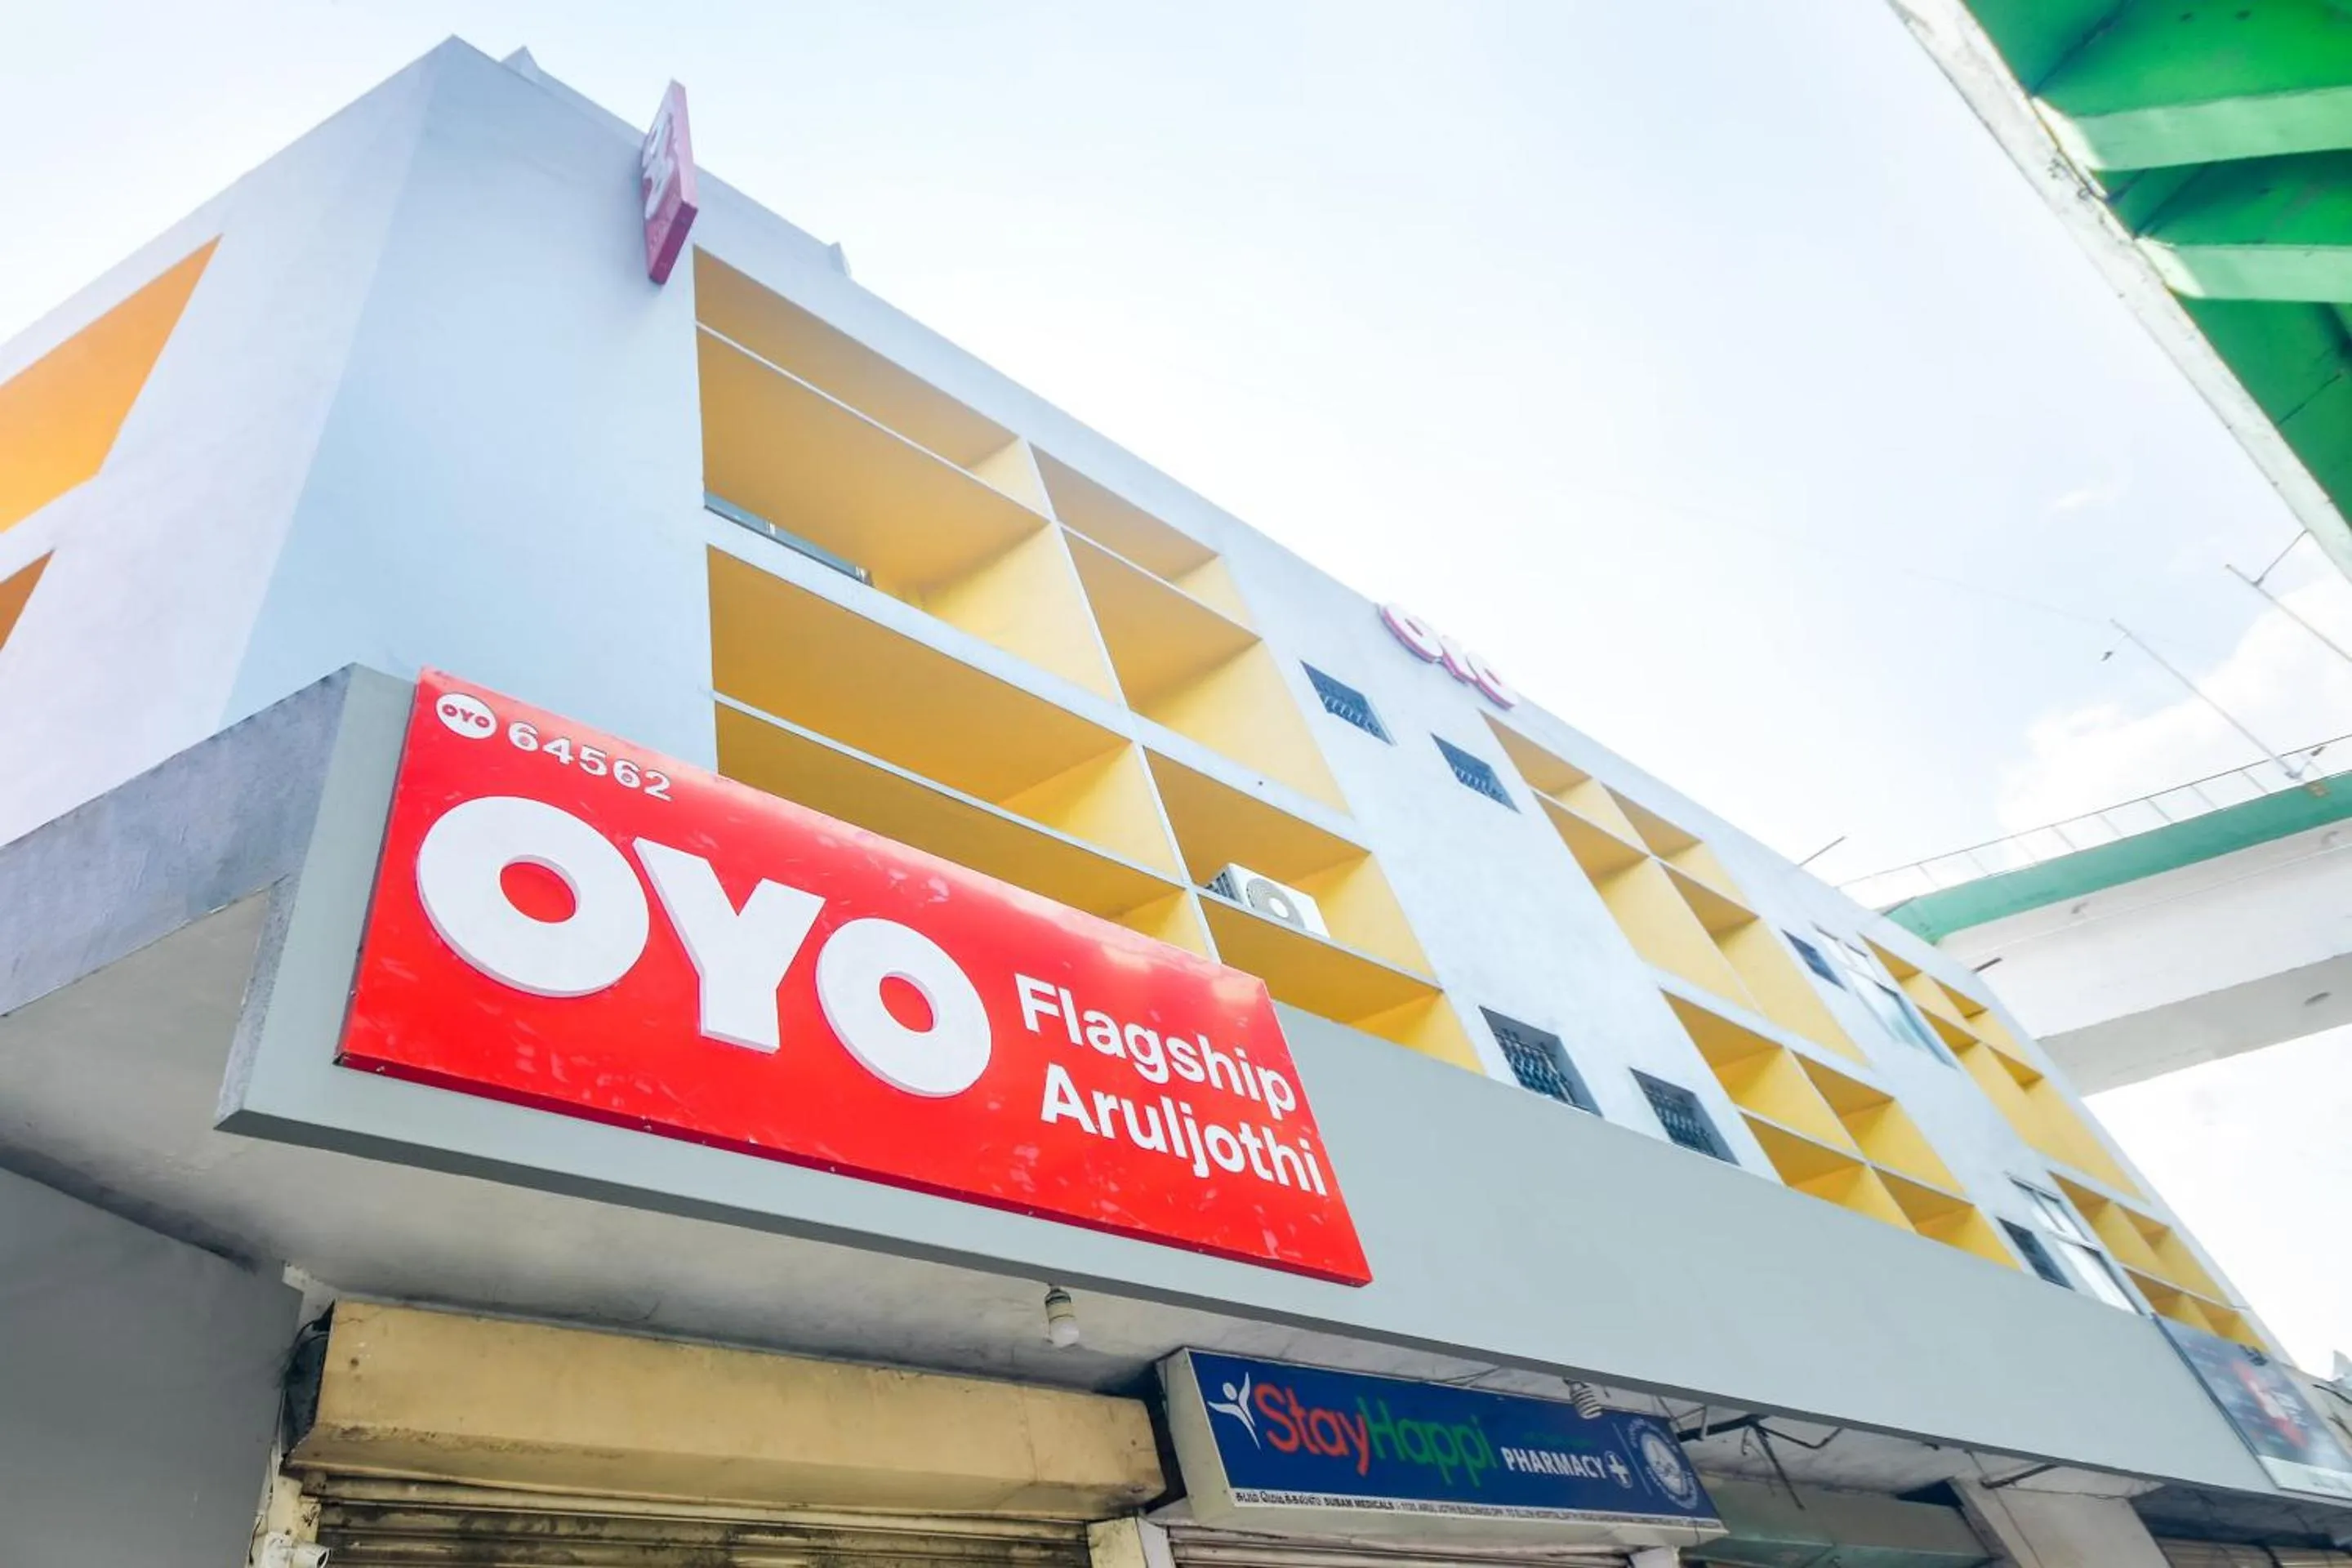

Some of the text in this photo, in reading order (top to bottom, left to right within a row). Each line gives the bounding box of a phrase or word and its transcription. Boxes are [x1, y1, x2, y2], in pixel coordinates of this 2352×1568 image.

[442, 704, 674, 802] OYO 64562
[416, 795, 992, 1099] OYO
[1014, 972, 1297, 1120] Flagship
[1040, 1062, 1328, 1196] Aruljothi
[1253, 1383, 1499, 1487] StayHappi
[1499, 1446, 1607, 1480] PHARMACY
